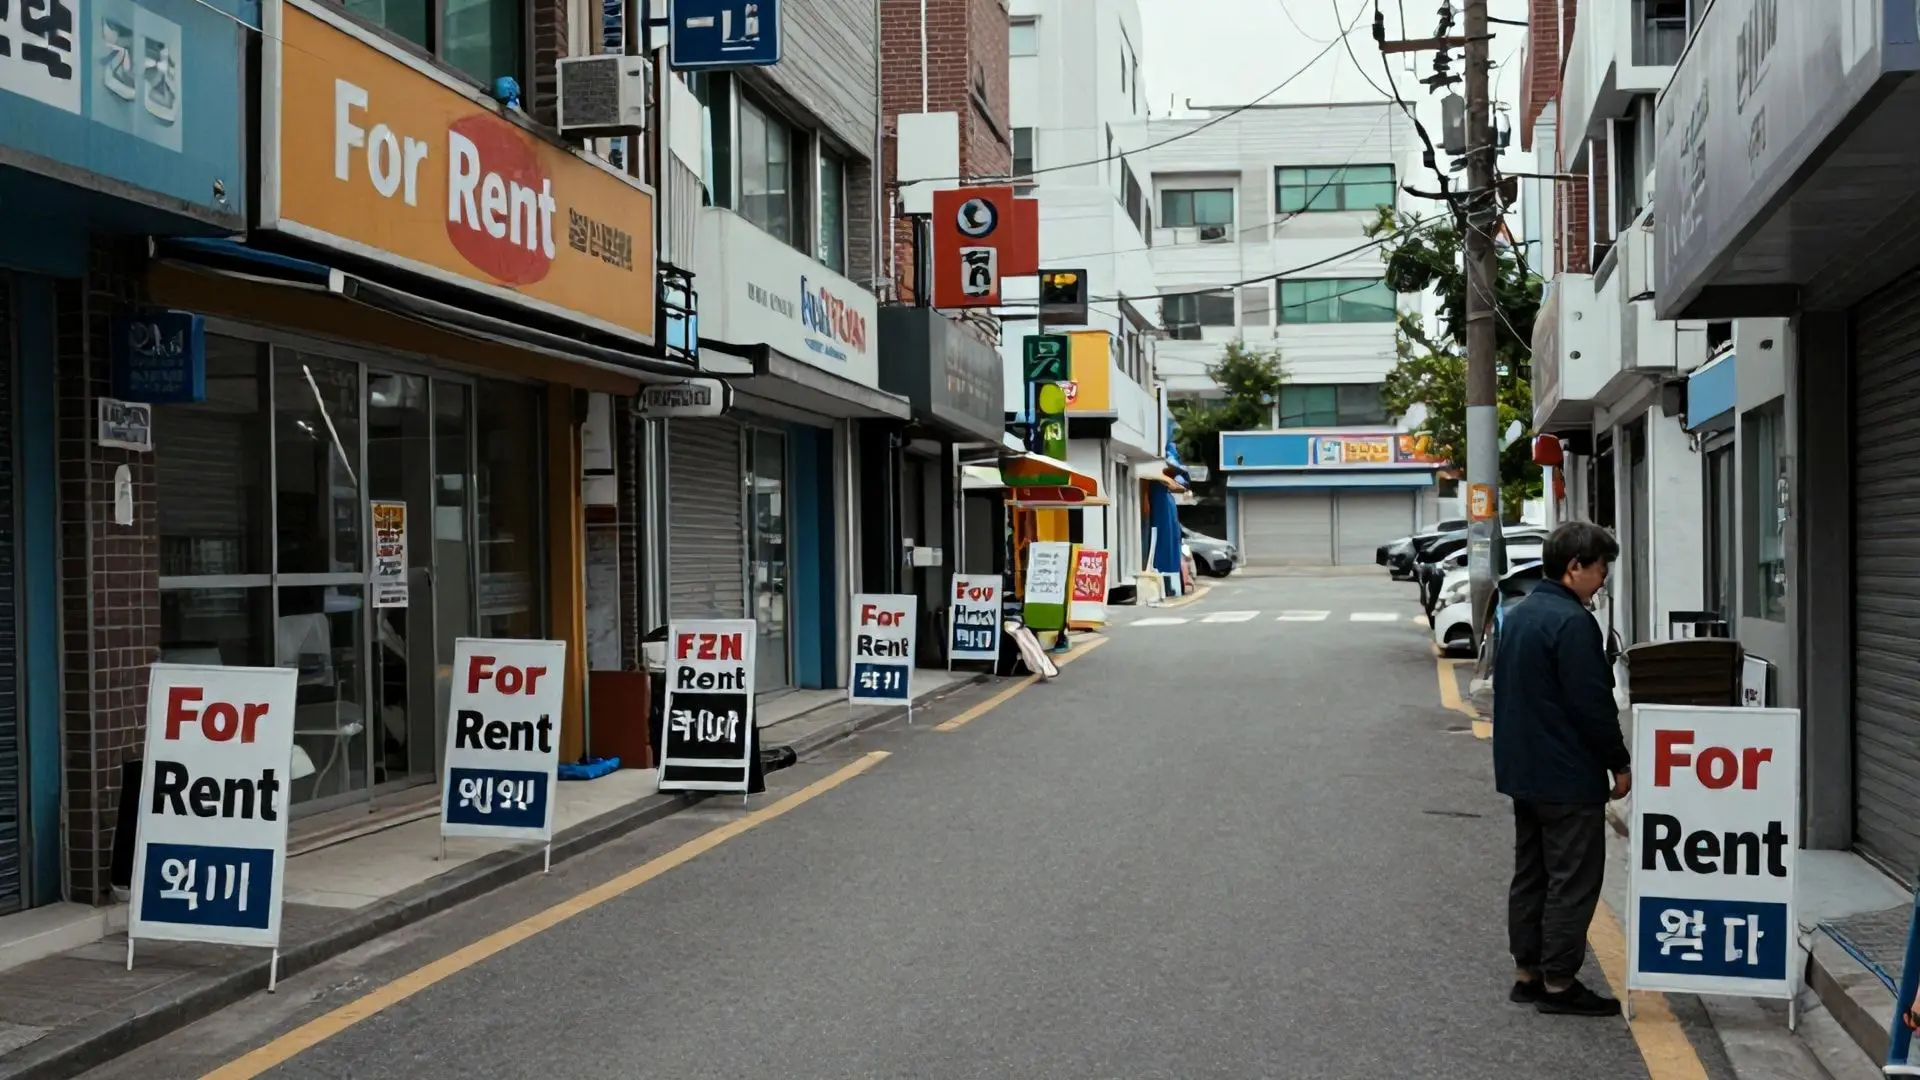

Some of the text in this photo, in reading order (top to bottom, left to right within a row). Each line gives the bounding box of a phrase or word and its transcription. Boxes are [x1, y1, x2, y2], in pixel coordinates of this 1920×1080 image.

[335, 78, 429, 206] For
[448, 129, 557, 260] Rent
[861, 604, 906, 627] For
[466, 655, 548, 696] For
[677, 665, 746, 690] Rent
[165, 686, 270, 744] For
[455, 709, 553, 754] Rent
[1653, 729, 1773, 790] For
[151, 760, 280, 822] Rent
[1641, 813, 1789, 878] Rent
